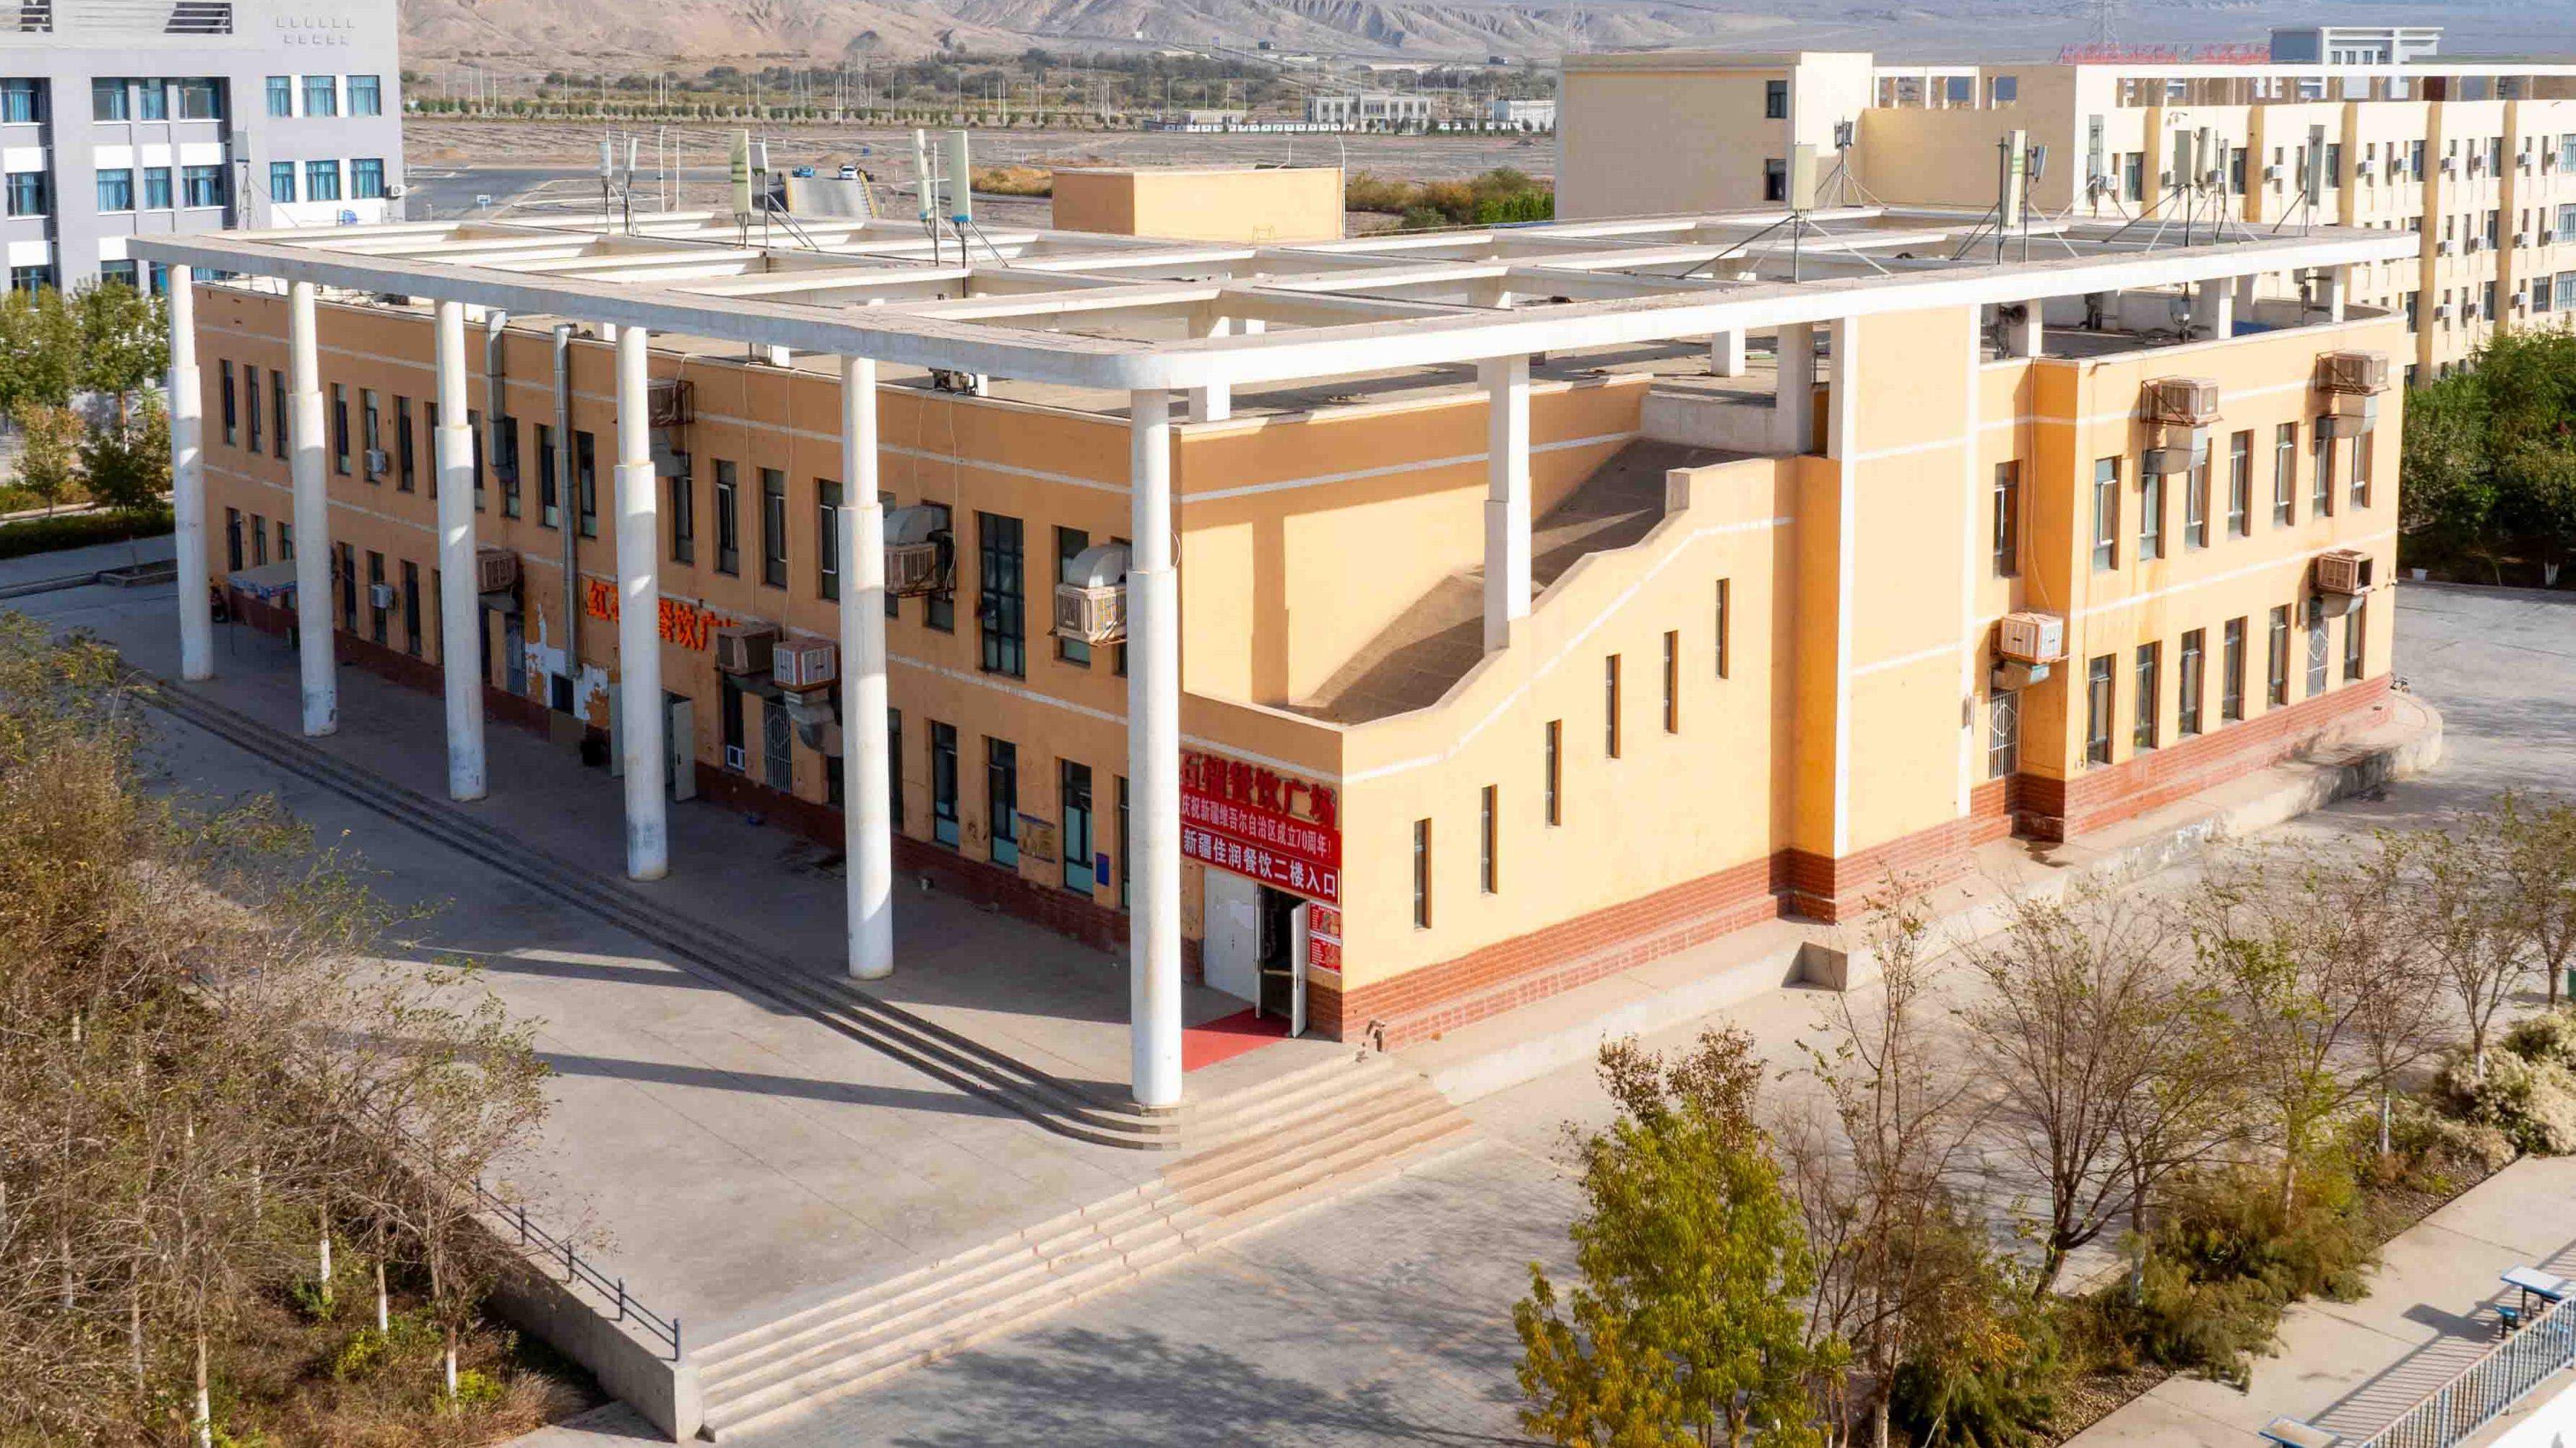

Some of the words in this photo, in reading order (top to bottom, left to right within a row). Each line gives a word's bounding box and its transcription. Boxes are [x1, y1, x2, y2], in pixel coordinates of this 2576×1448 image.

[1184, 828, 1336, 897] 新疆佳润餐饮二楼入口
